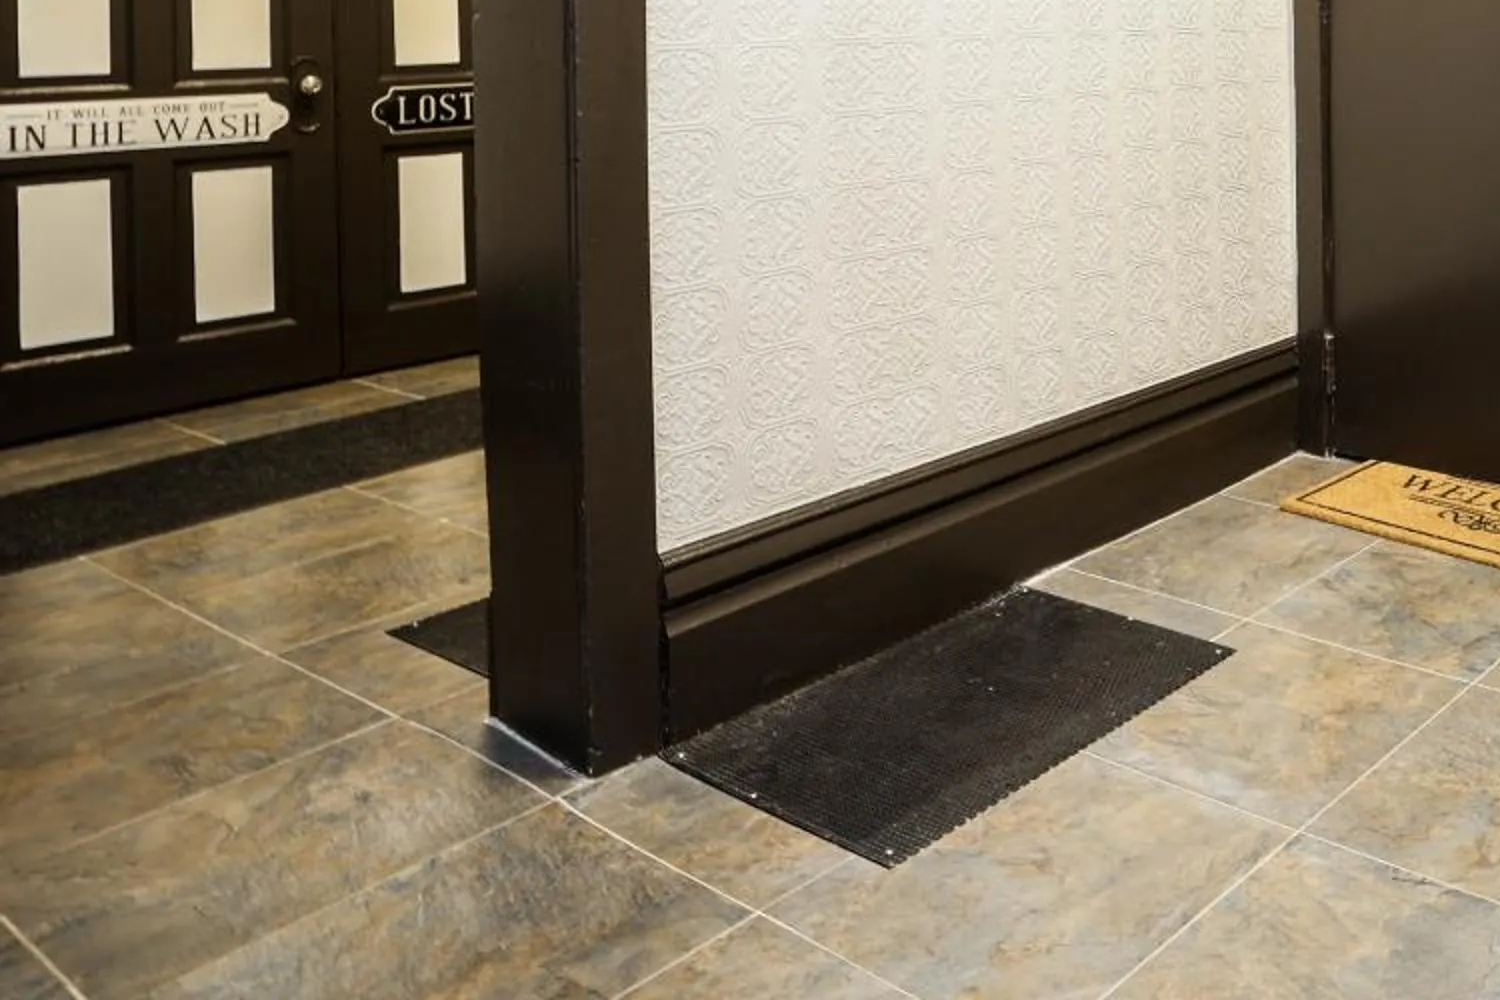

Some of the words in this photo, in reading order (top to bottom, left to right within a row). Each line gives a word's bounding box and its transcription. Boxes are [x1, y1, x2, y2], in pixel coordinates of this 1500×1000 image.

[46, 109, 62, 121] IT
[71, 106, 109, 119] WILL
[119, 105, 145, 117] ALL
[199, 100, 225, 113] OUT
[397, 91, 475, 126] LOST
[8, 124, 47, 153] IN
[64, 120, 138, 149] THE
[154, 111, 260, 144] WASH
